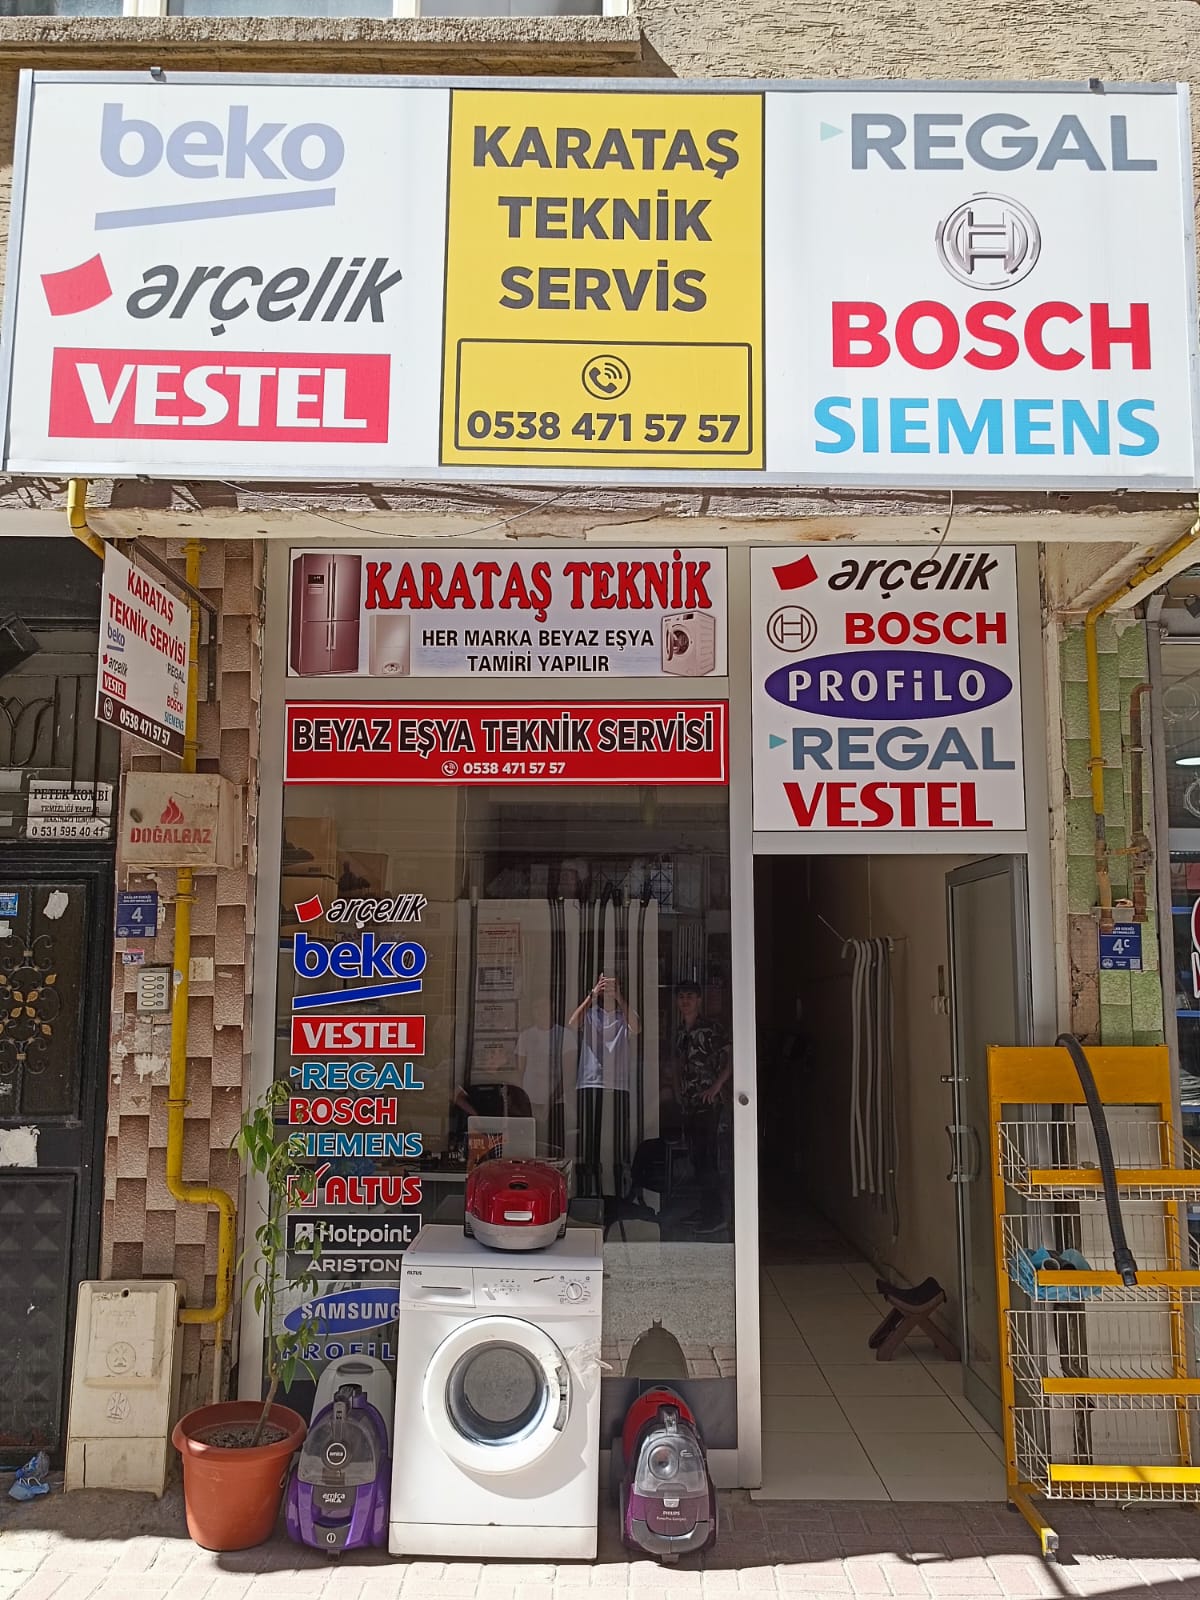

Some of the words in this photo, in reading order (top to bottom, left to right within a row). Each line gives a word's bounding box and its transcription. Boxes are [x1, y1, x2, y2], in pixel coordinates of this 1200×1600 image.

[100, 103, 345, 182] beko
[473, 125, 740, 180] KARATAŞ
[851, 113, 1158, 171] REGAL
[498, 189, 713, 241] TEKNİK
[126, 256, 403, 336] arçelik
[499, 259, 707, 312] SERVİS
[831, 300, 1152, 371] BOSCH
[76, 363, 367, 428] VESTEL
[467, 410, 561, 440] 0538
[571, 412, 632, 442] 471
[644, 414, 687, 443] 57
[697, 414, 741, 444] 57
[813, 396, 1160, 457] SIEMENS
[365, 560, 552, 622] KARATAŞ
[563, 549, 712, 609] TEKNİK
[828, 552, 998, 599] arçelik
[127, 568, 174, 626] KARATAŞ
[107, 622, 126, 648] beko
[108, 592, 148, 643] TEKNİK
[149, 623, 186, 667] SERVİSİ
[422, 630, 459, 647] HER
[464, 630, 532, 648] MARKA
[539, 630, 599, 648] BEYAZ
[605, 630, 654, 651] EŞYA
[845, 611, 1007, 645] BOSCH
[108, 656, 129, 677] arçelik
[167, 662, 186, 684] REGAL
[467, 650, 532, 672] TAMİRİ
[537, 655, 609, 672] YAPILIR
[104, 674, 125, 698] VESTEL
[164, 711, 184, 731] SIEMENS
[166, 695, 184, 715] BOSCH
[119, 706, 140, 730] 0538
[139, 718, 153, 737] 471
[152, 724, 162, 742] 57
[161, 729, 171, 746] 57
[292, 718, 392, 752] BEYAZ
[399, 718, 475, 759] EŞYA
[481, 712, 594, 753] TEKNİK
[597, 712, 714, 752] SERVİSİ
[792, 726, 1016, 771] REGAL
[463, 762, 499, 775] 0538
[502, 762, 526, 775] 471
[528, 762, 546, 775] 57
[548, 762, 566, 775] 57
[783, 782, 994, 827] VESTEL
[40, 826, 57, 837] 531
[60, 826, 77, 837] 595
[79, 826, 91, 837] 40
[130, 826, 212, 843] DOĞALGAZ
[131, 907, 143, 923] 4
[326, 894, 427, 928] arçelik
[293, 932, 427, 978] beko
[302, 1022, 416, 1049] VESTEL
[302, 1062, 424, 1090] REGAL
[288, 1097, 398, 1125] BOSCH
[324, 1175, 423, 1206] ALTUS
[320, 1224, 412, 1247] Hotpoint
[306, 1259, 400, 1272] ARISTON
